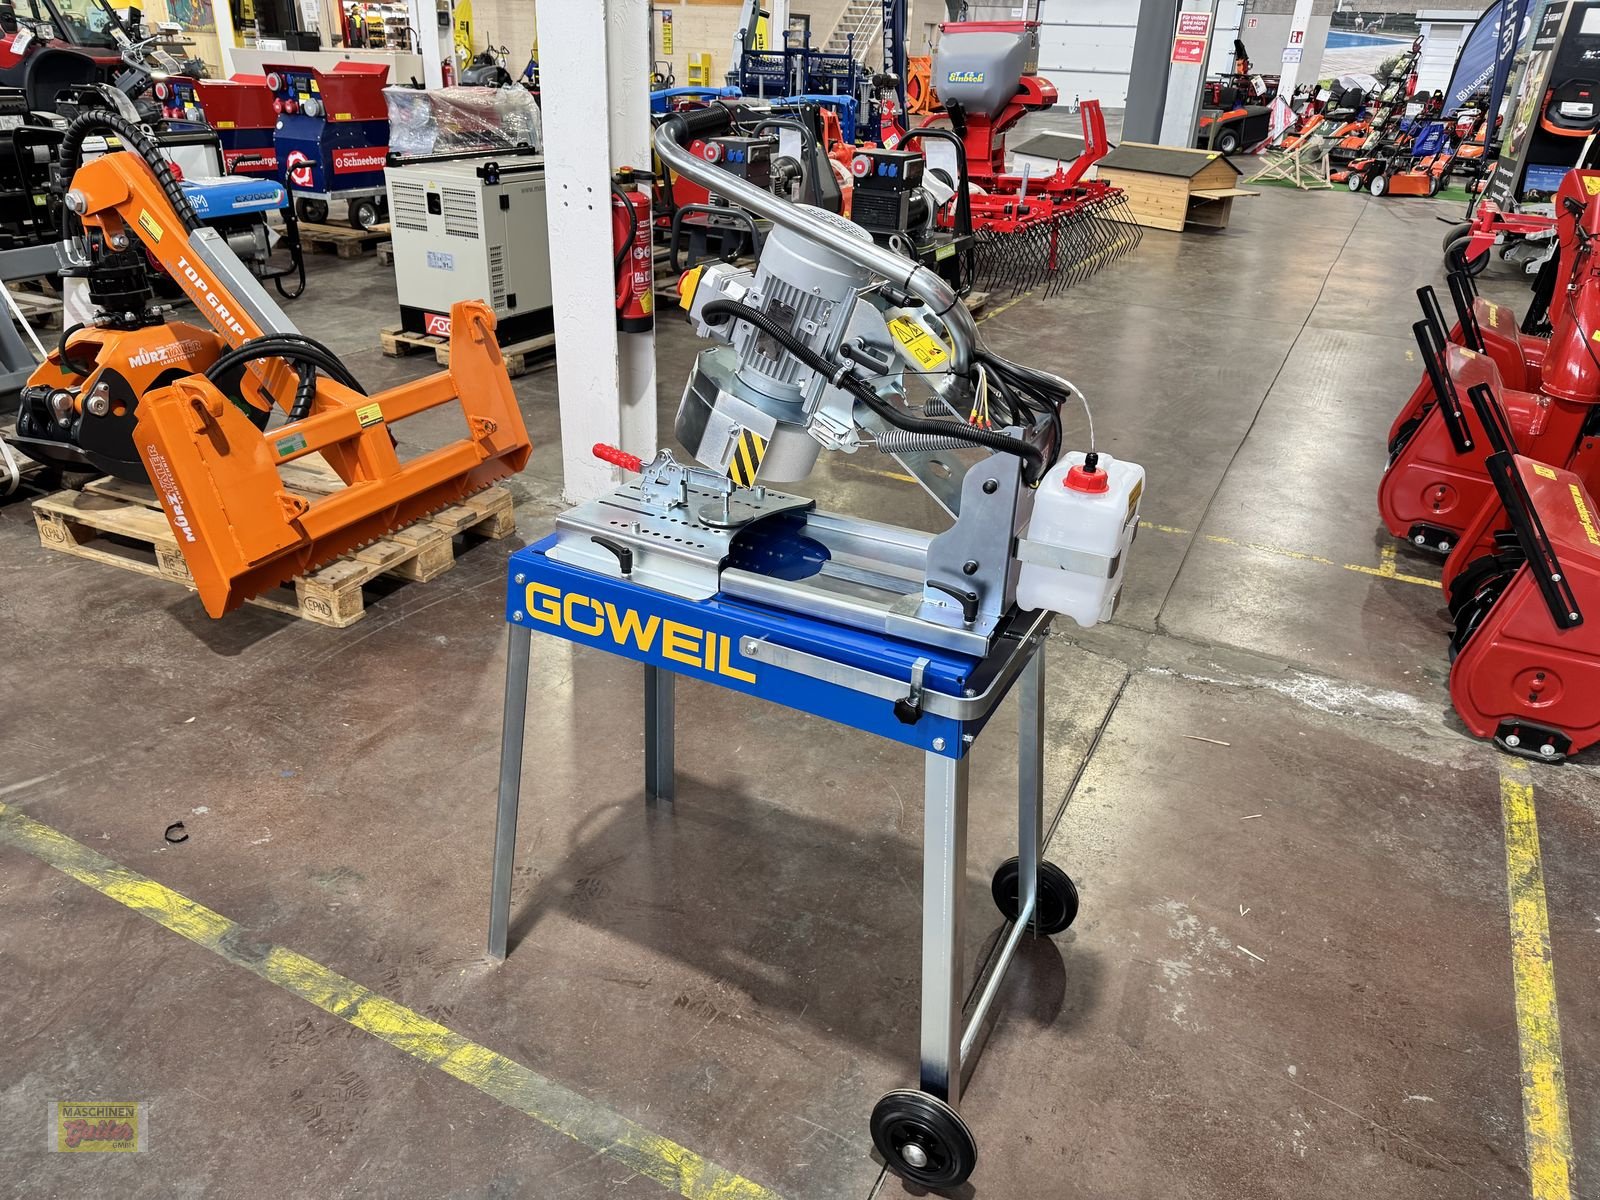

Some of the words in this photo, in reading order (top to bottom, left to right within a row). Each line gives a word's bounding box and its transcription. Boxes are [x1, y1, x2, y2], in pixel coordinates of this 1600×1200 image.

[1464, 62, 1496, 95] Husqvar
[343, 155, 387, 168] Schneeberg
[177, 255, 209, 292] TOP
[205, 291, 246, 336] GRIP
[160, 353, 196, 366] LANDTECHNIK
